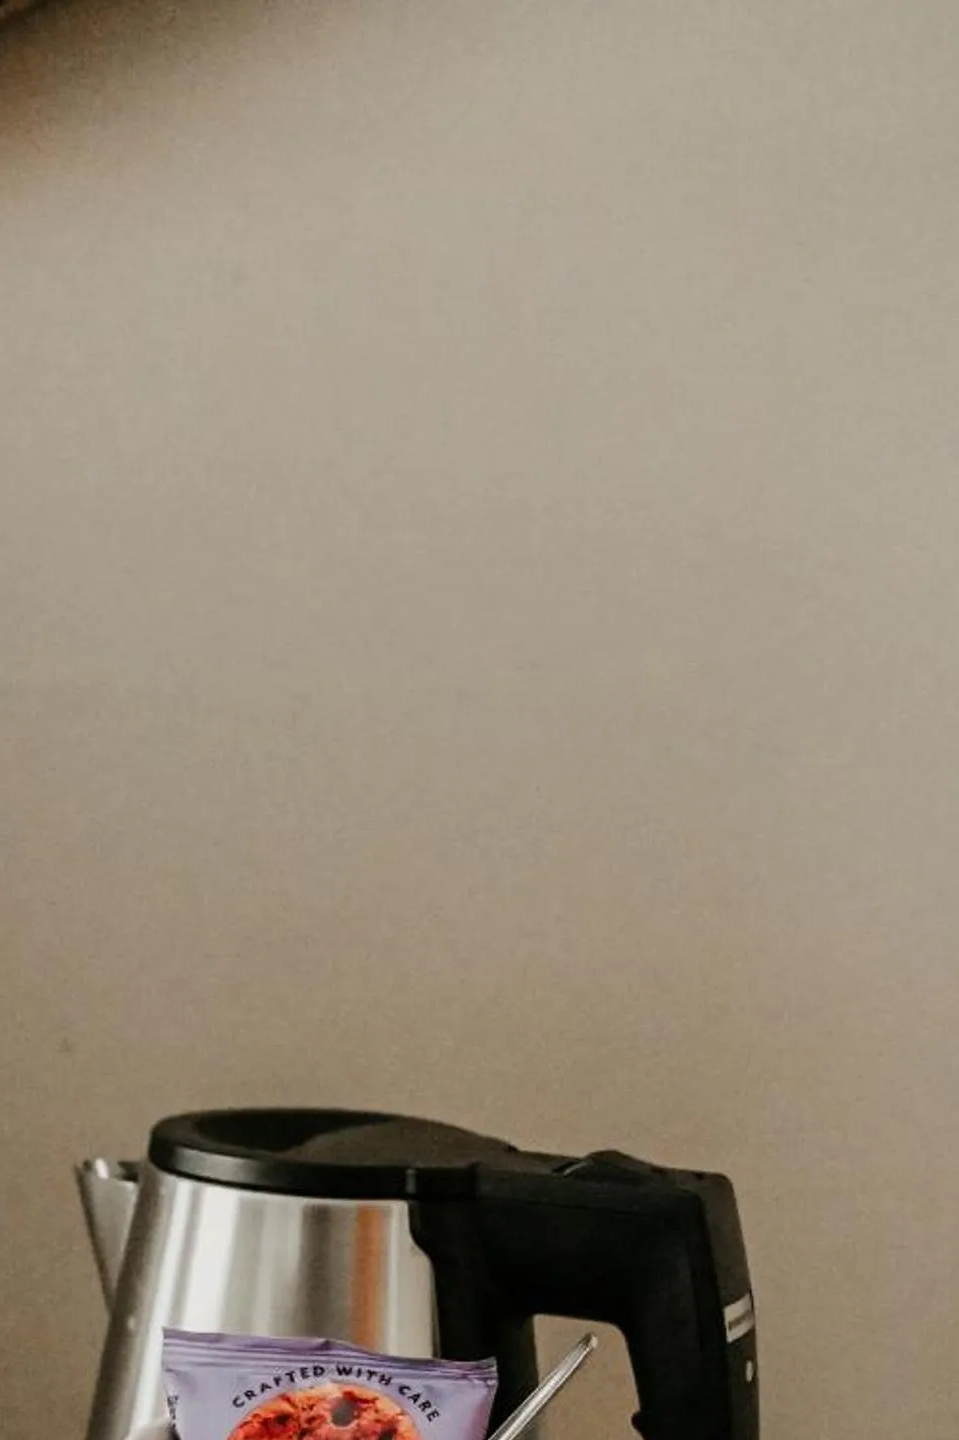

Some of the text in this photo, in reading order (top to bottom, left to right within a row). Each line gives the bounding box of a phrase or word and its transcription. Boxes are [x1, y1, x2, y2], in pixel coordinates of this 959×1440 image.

[232, 1364, 441, 1423] CRAFTED WITH CARE
